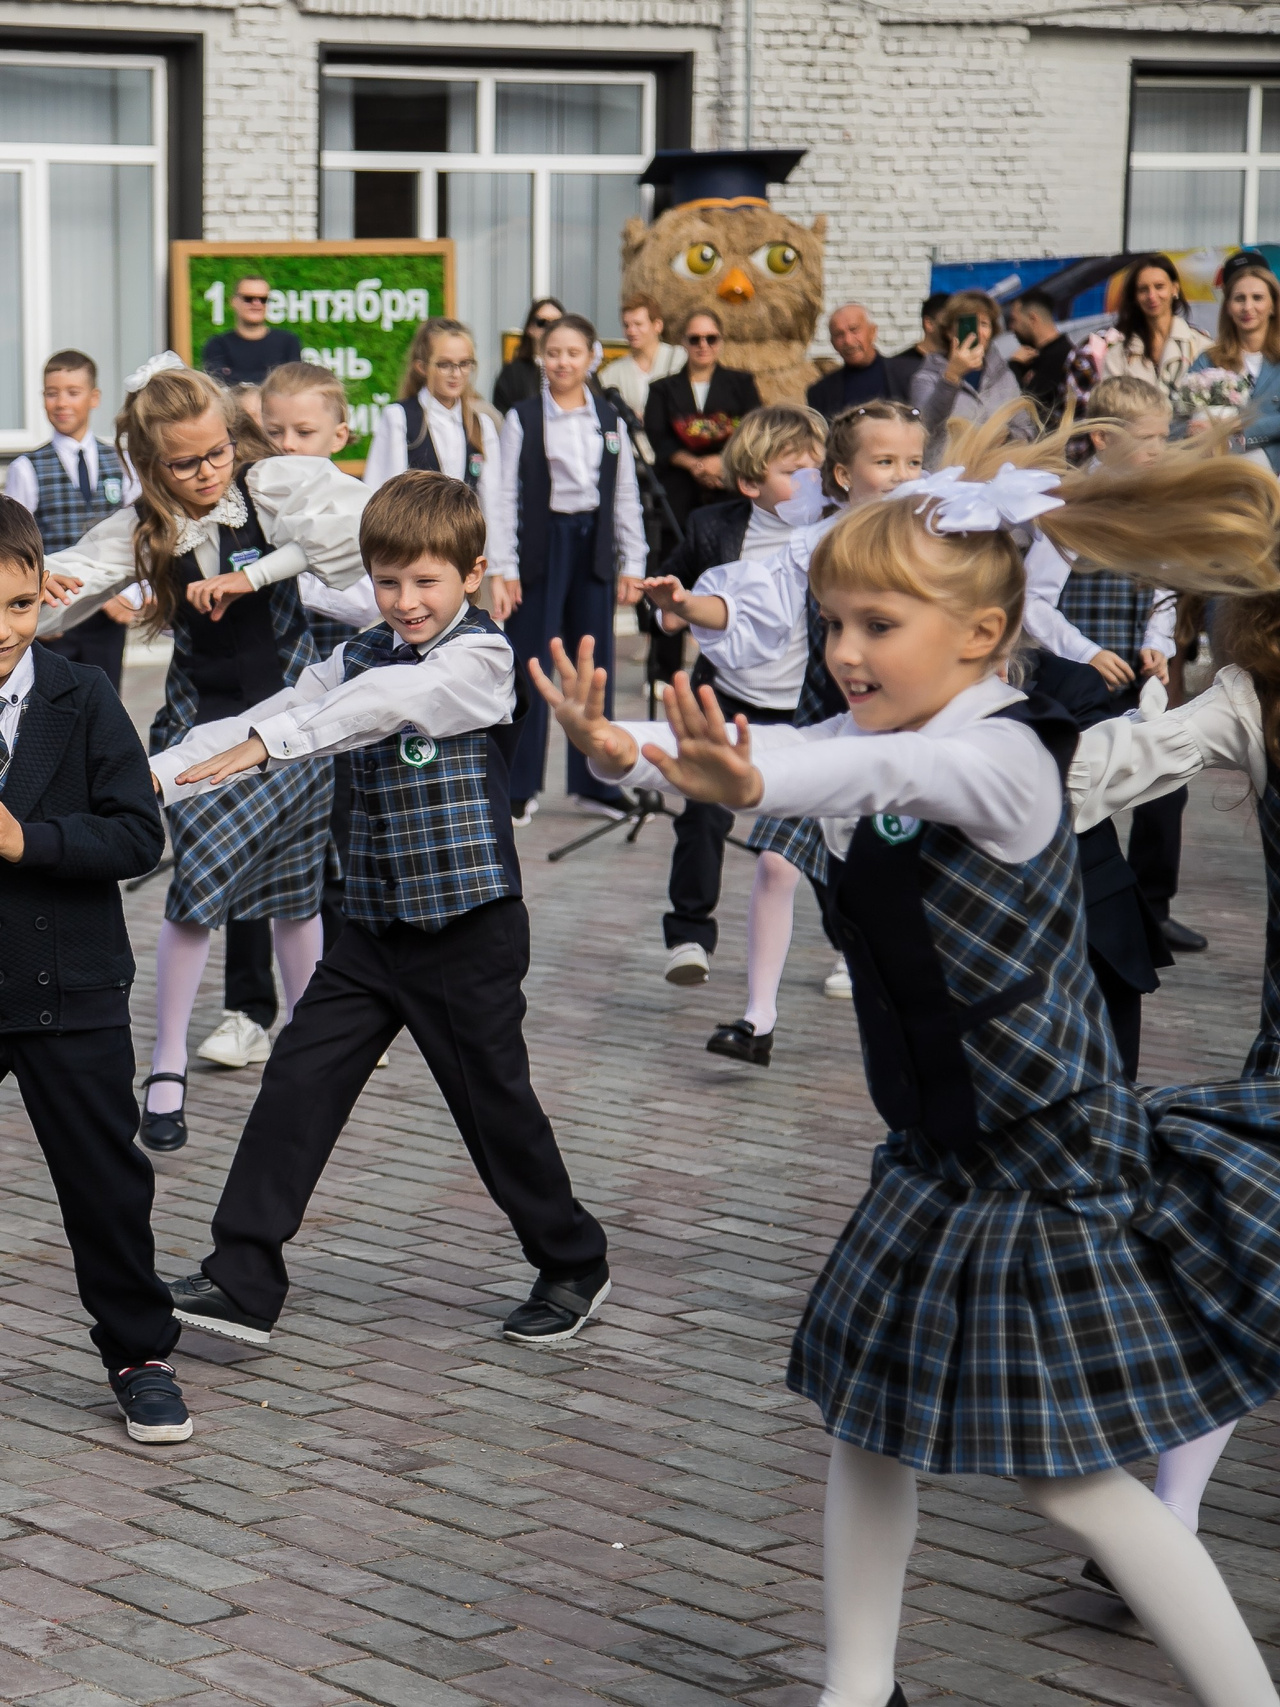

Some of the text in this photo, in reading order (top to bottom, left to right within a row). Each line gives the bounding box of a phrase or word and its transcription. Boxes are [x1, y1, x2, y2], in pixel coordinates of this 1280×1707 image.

[204, 277, 430, 332] 1 ентября
[300, 346, 373, 380] ень
